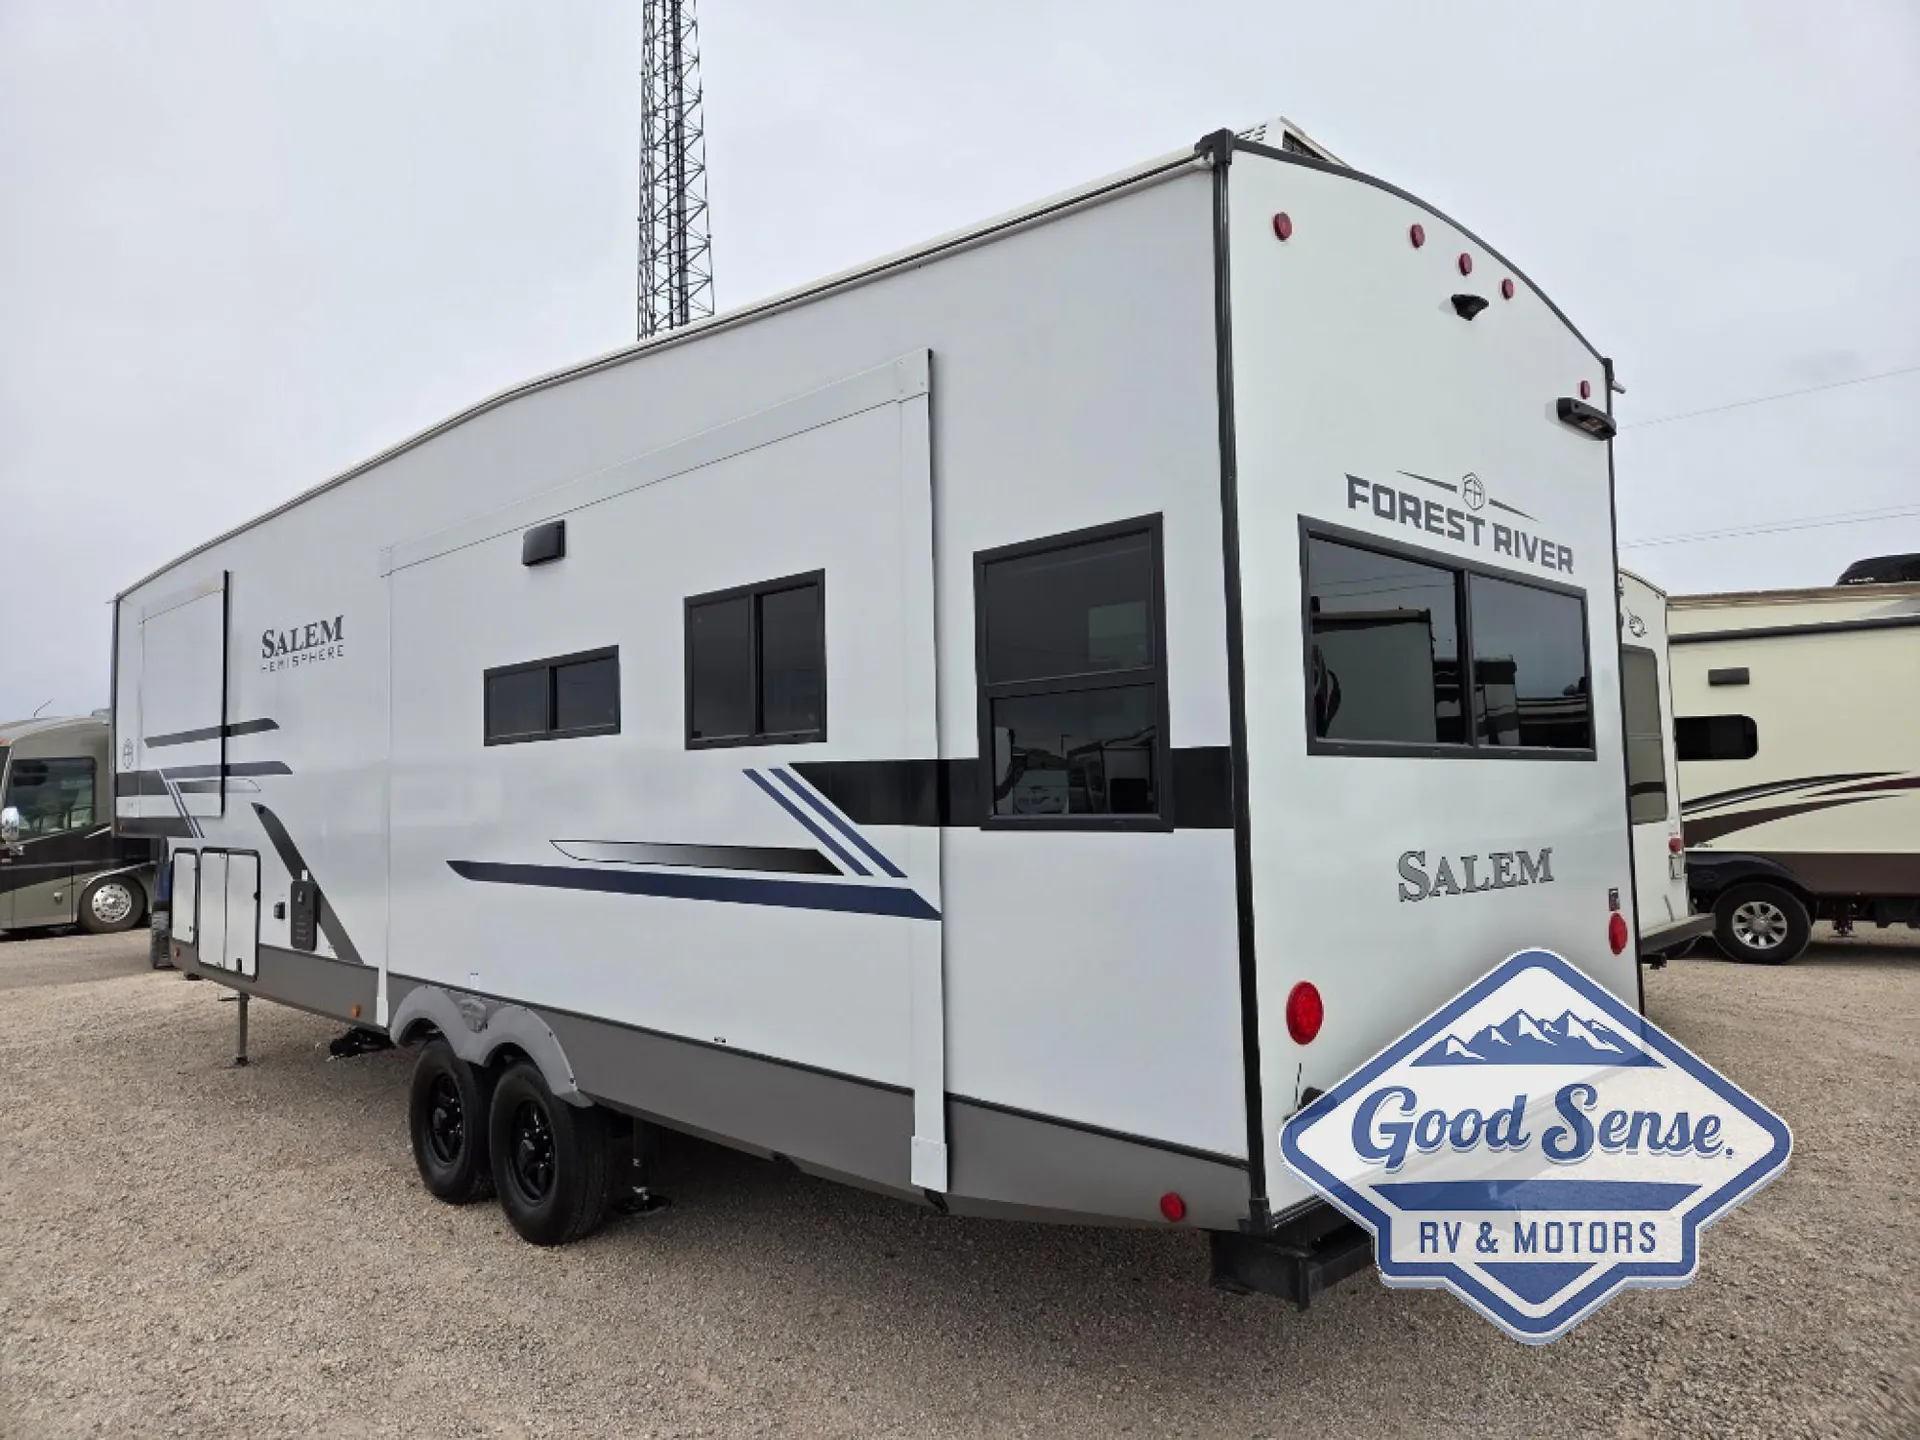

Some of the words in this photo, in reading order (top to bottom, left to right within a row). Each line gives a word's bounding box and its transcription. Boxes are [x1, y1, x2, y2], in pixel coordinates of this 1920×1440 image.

[1345, 473, 1485, 546] FOREST
[1493, 523, 1574, 574] RIVER
[262, 614, 344, 658] SALEM
[1398, 848, 1554, 902] SALEM
